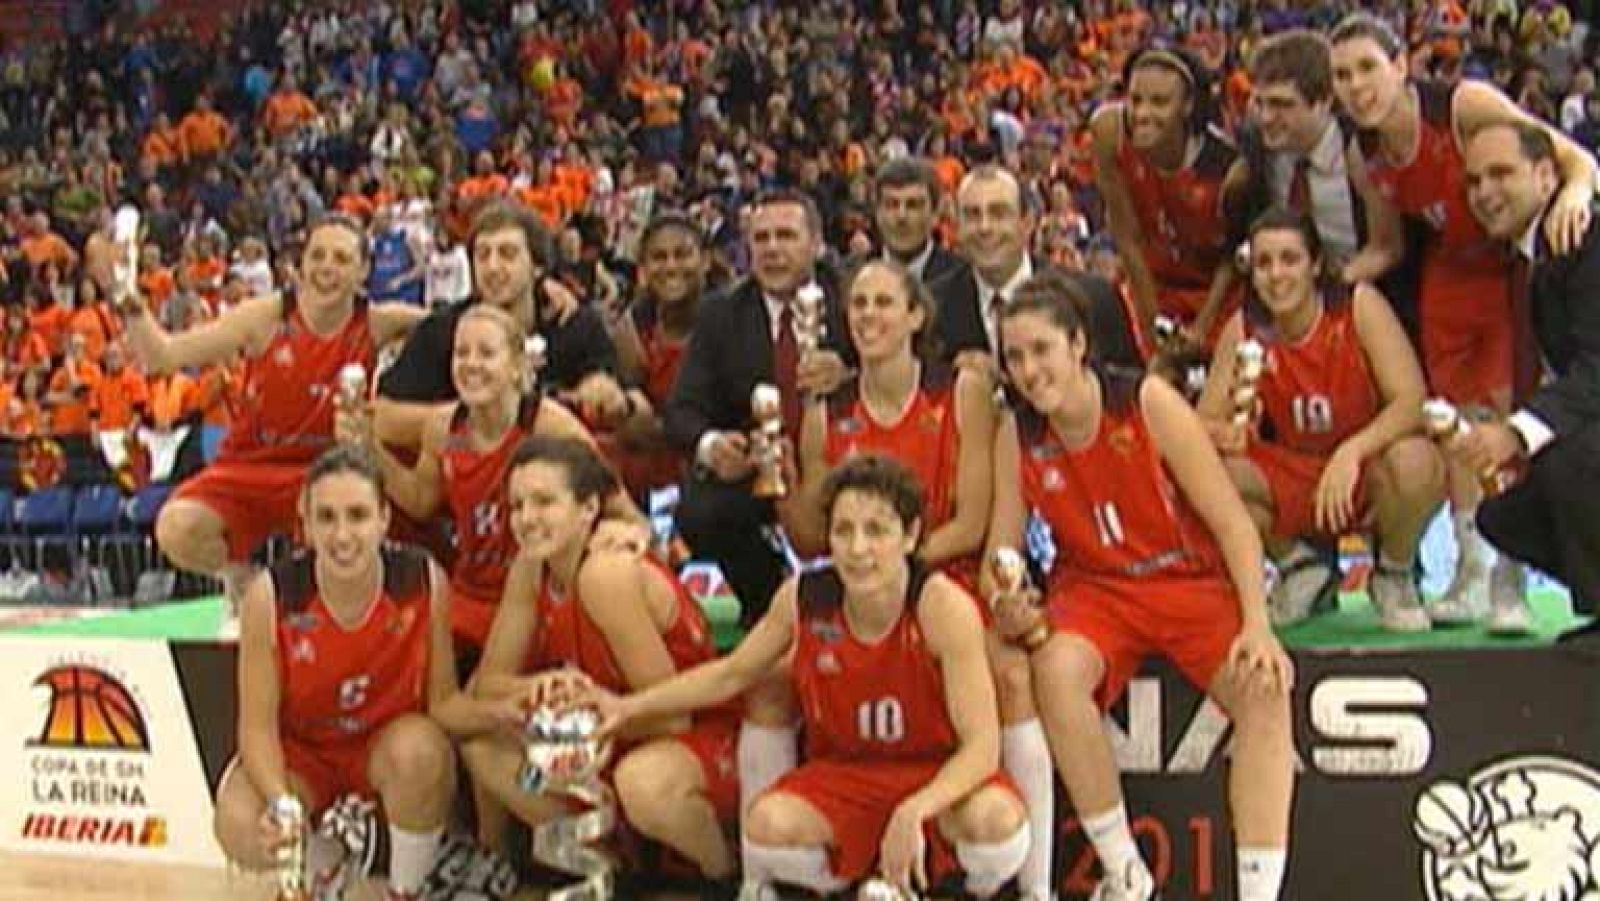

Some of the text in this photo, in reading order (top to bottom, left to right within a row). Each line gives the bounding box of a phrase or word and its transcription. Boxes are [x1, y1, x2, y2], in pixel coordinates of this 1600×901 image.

[1093, 501, 1123, 545] 11
[857, 696, 904, 742] 10
[32, 778, 147, 806] LA REINA
[22, 812, 134, 845] IBERIA
